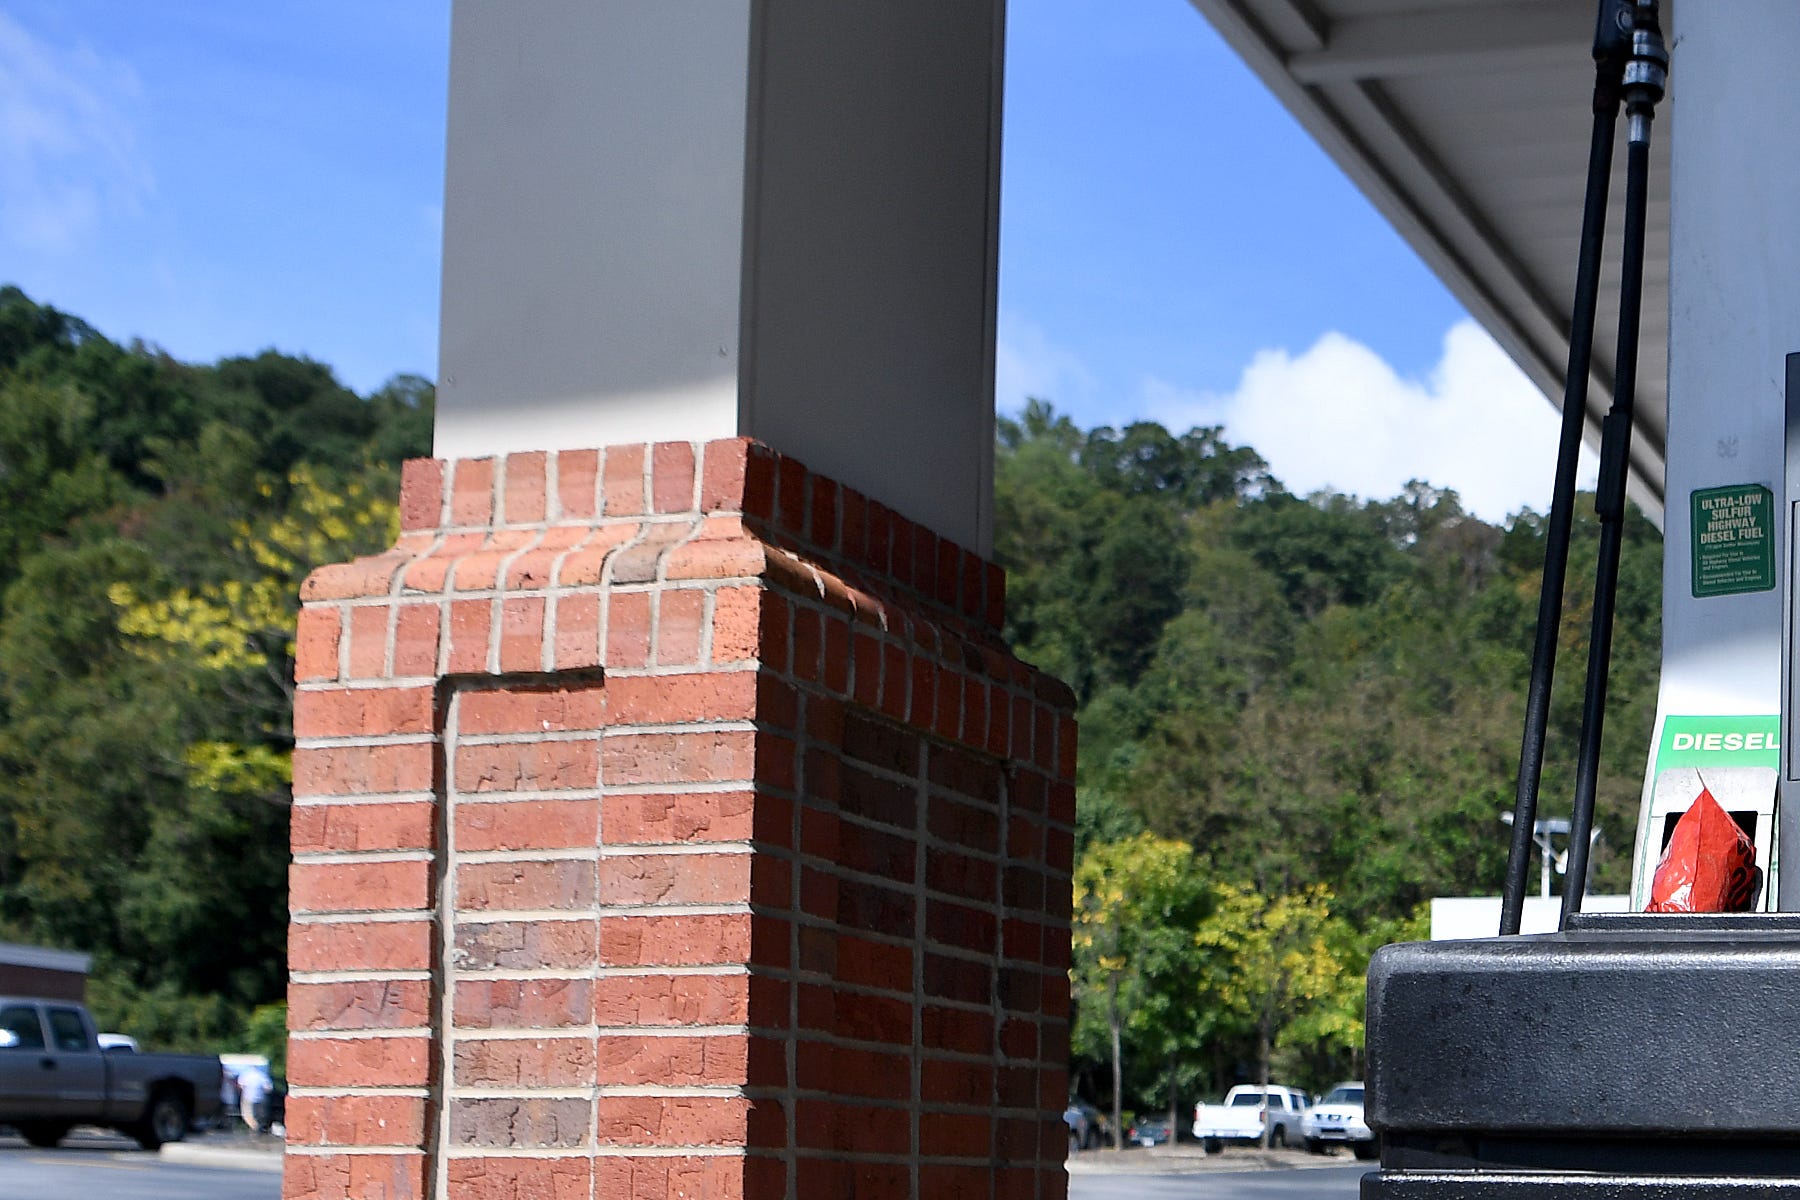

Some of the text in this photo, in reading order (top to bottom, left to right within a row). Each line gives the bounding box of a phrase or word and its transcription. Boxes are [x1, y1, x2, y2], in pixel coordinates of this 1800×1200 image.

[1701, 494, 1762, 511] ULTRA-LOW
[1711, 506, 1752, 520] SULFUR
[1707, 517, 1756, 532] HIGHWAY
[1700, 527, 1764, 545] DIESEL FUEL
[1672, 733, 1780, 751] DIESEL
